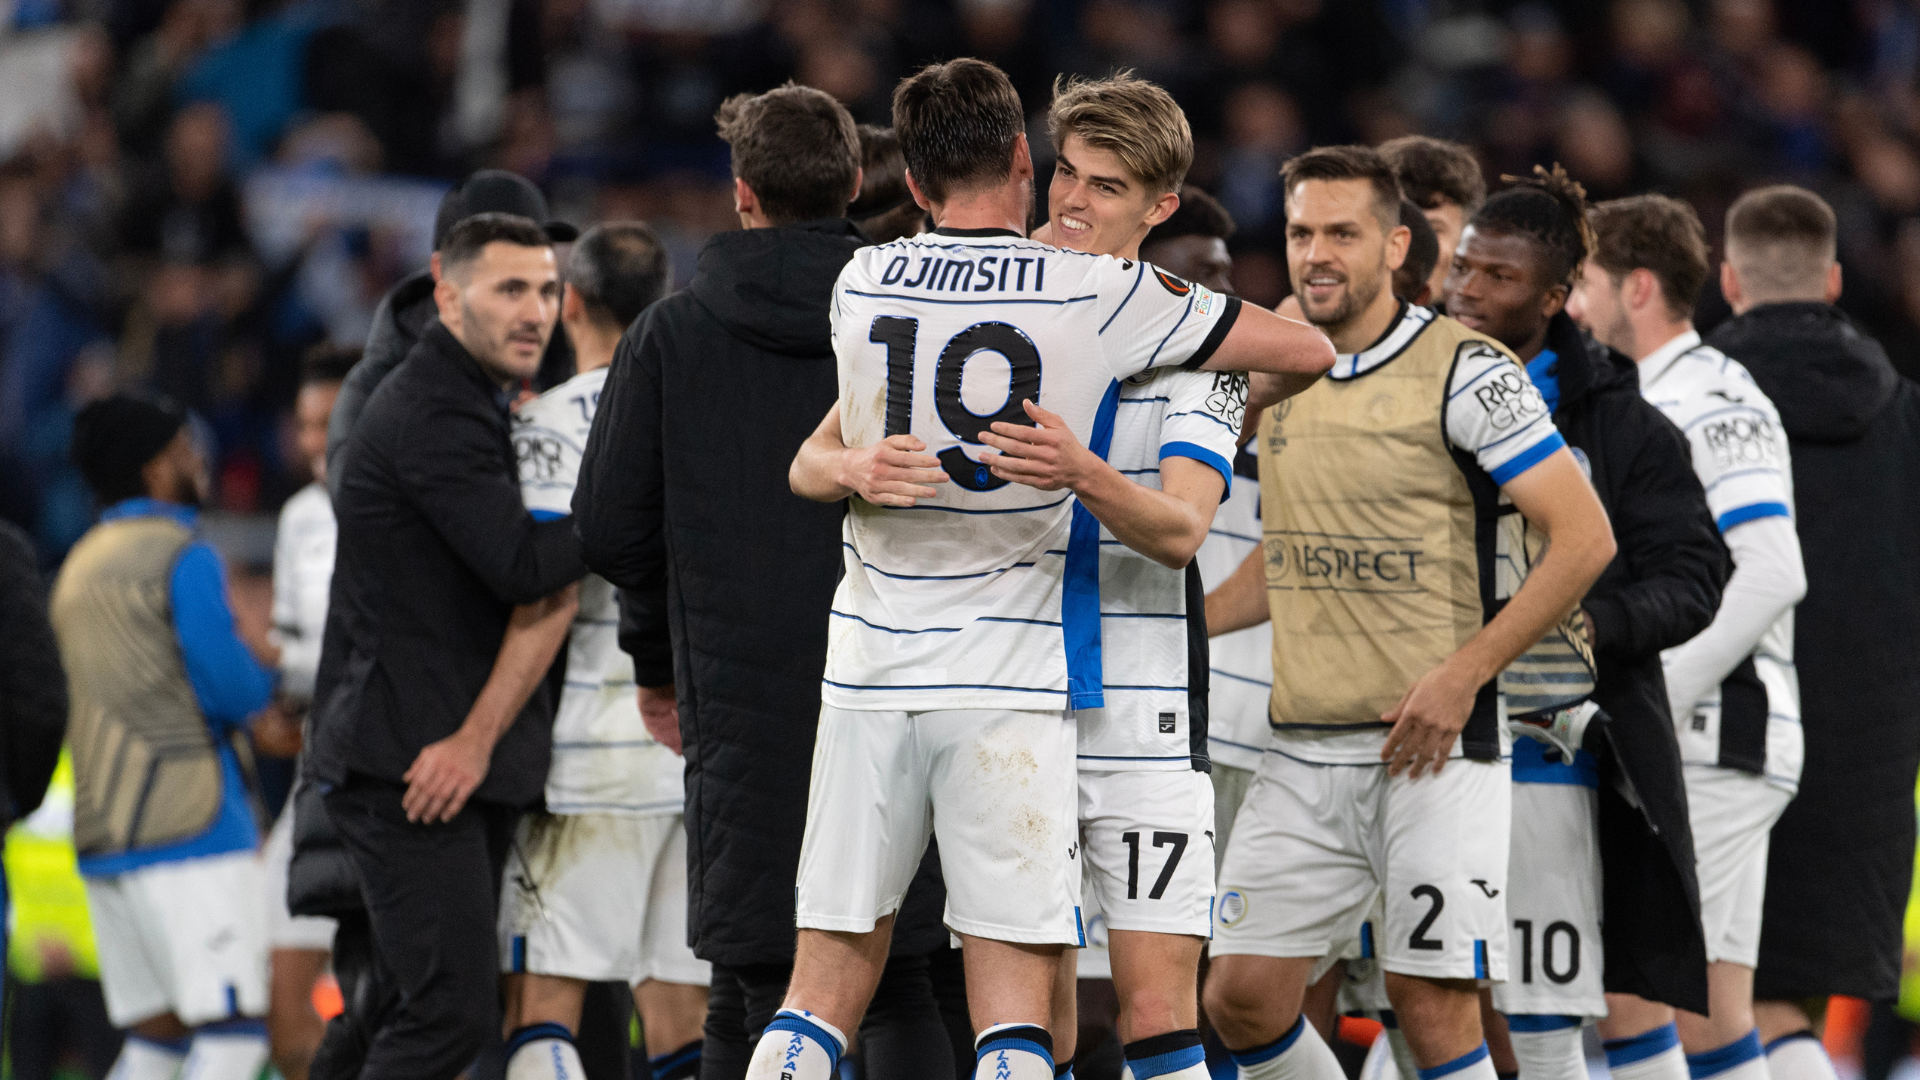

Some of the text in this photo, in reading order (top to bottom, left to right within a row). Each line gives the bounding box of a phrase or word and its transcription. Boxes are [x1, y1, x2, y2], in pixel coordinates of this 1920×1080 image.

[880, 255, 1045, 292] DJIMSITI
[1199, 290, 1211, 315] FOUND
[869, 315, 1043, 492] 19
[1122, 831, 1188, 900] 17
[1409, 884, 1444, 951] 2
[1513, 919, 1580, 985] 10
